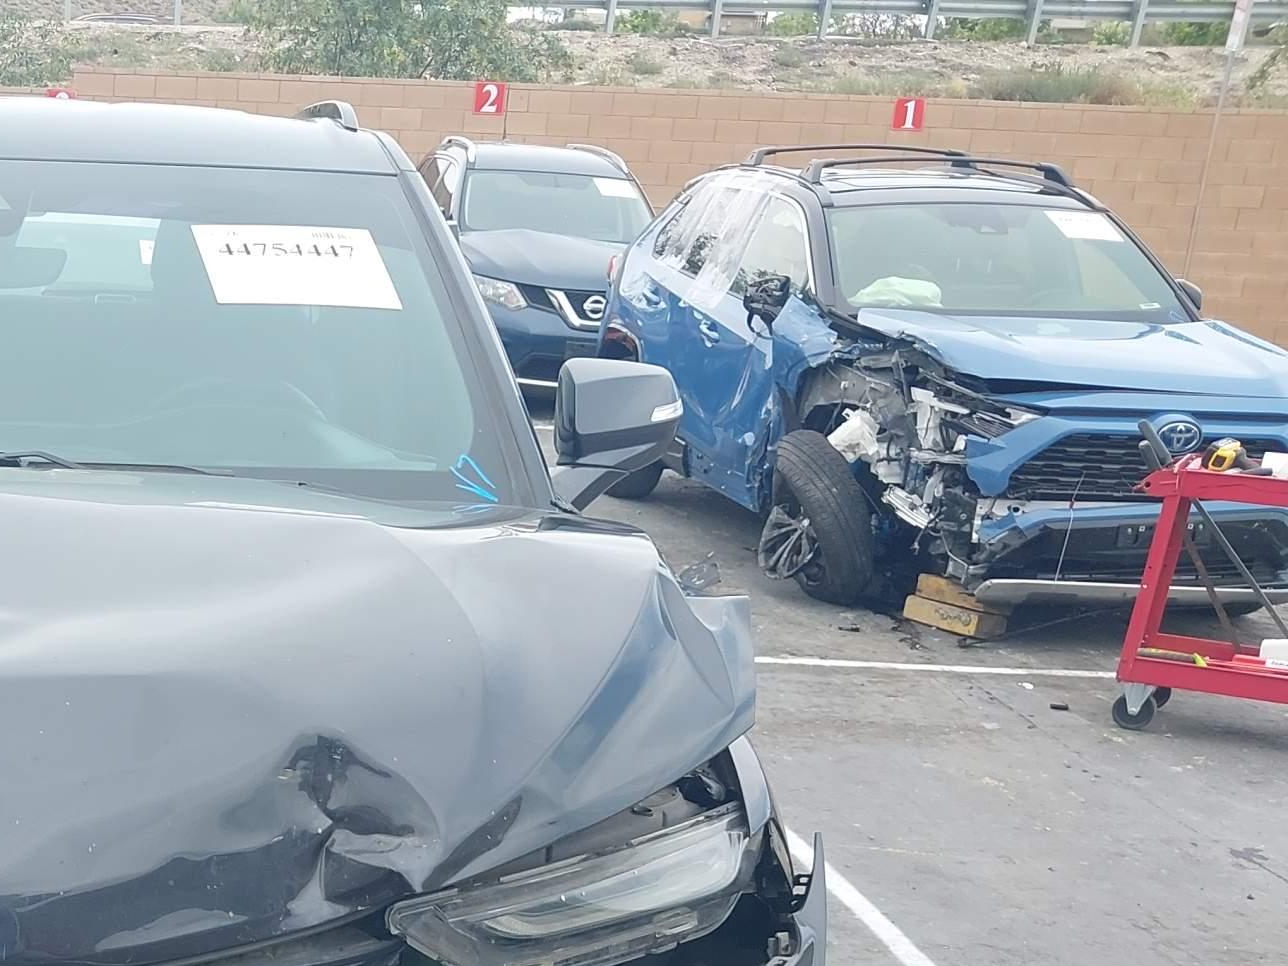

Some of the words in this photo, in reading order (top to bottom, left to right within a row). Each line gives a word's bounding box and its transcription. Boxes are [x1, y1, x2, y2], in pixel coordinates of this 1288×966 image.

[479, 84, 498, 113] 2
[901, 100, 916, 129] 1
[218, 243, 354, 258] 44754447
